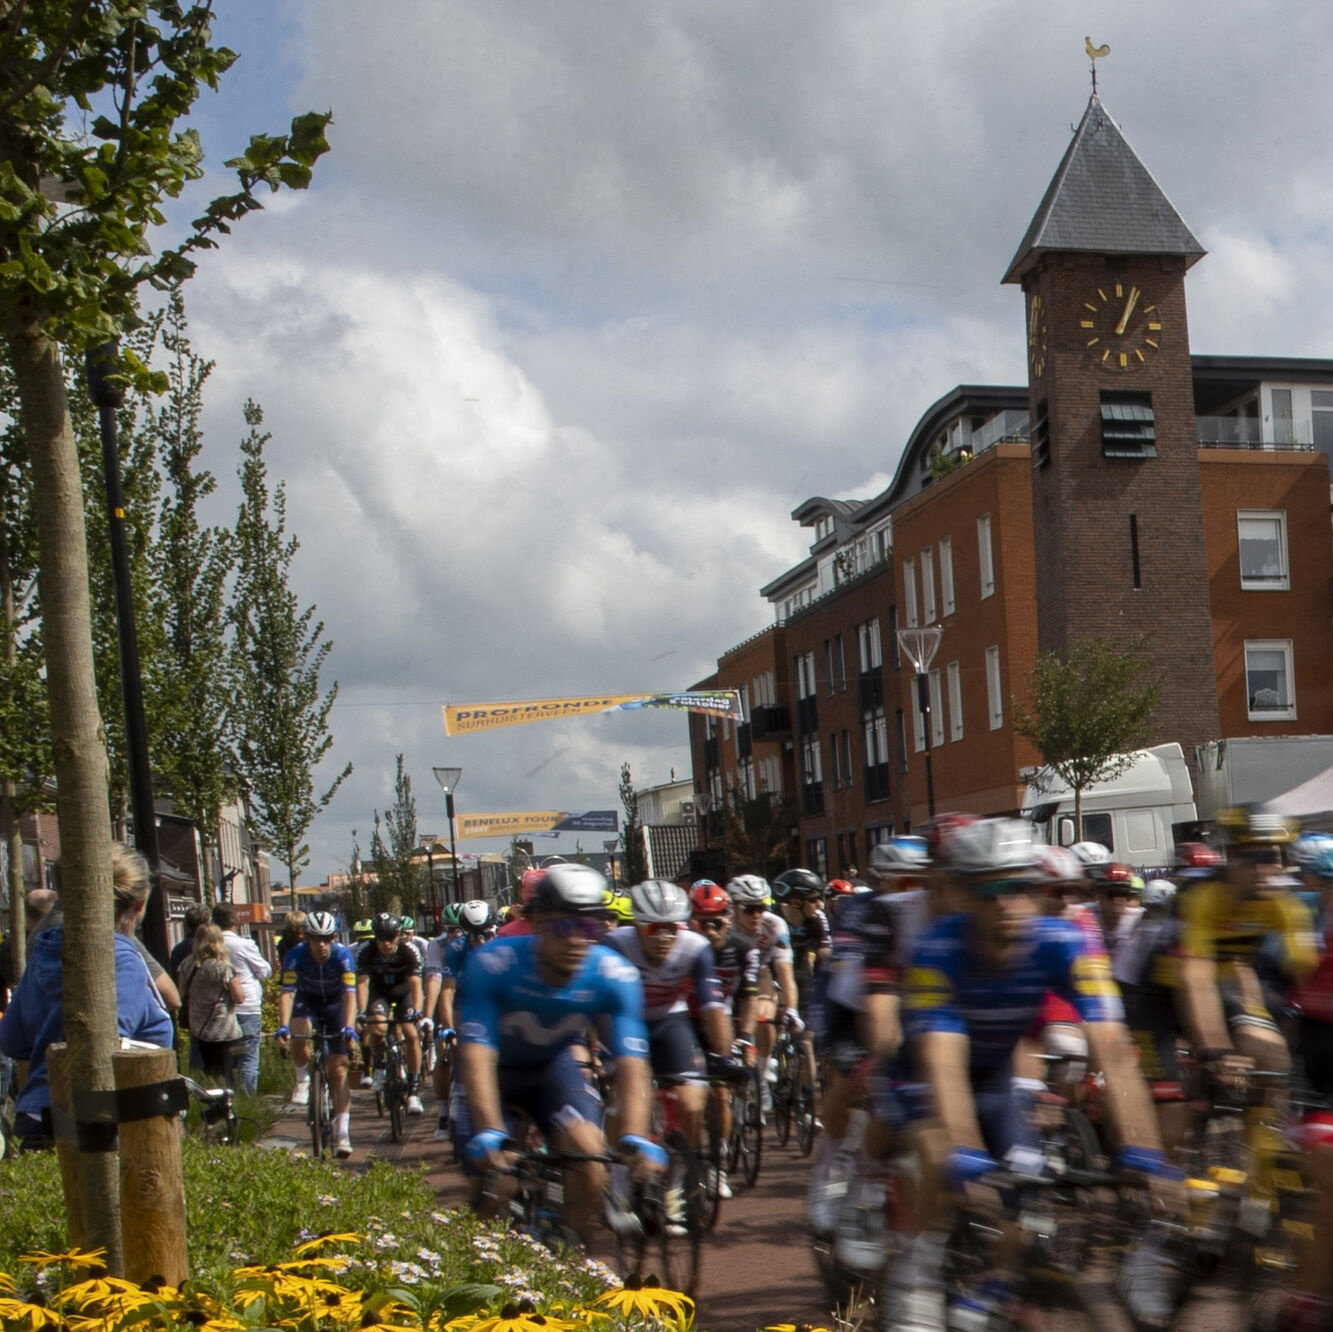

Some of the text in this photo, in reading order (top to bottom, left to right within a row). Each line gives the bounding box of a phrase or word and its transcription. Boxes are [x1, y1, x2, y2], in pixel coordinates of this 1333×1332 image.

[456, 699, 614, 722] PROFRONDE
[464, 815, 559, 827] BENELUX TOUR
